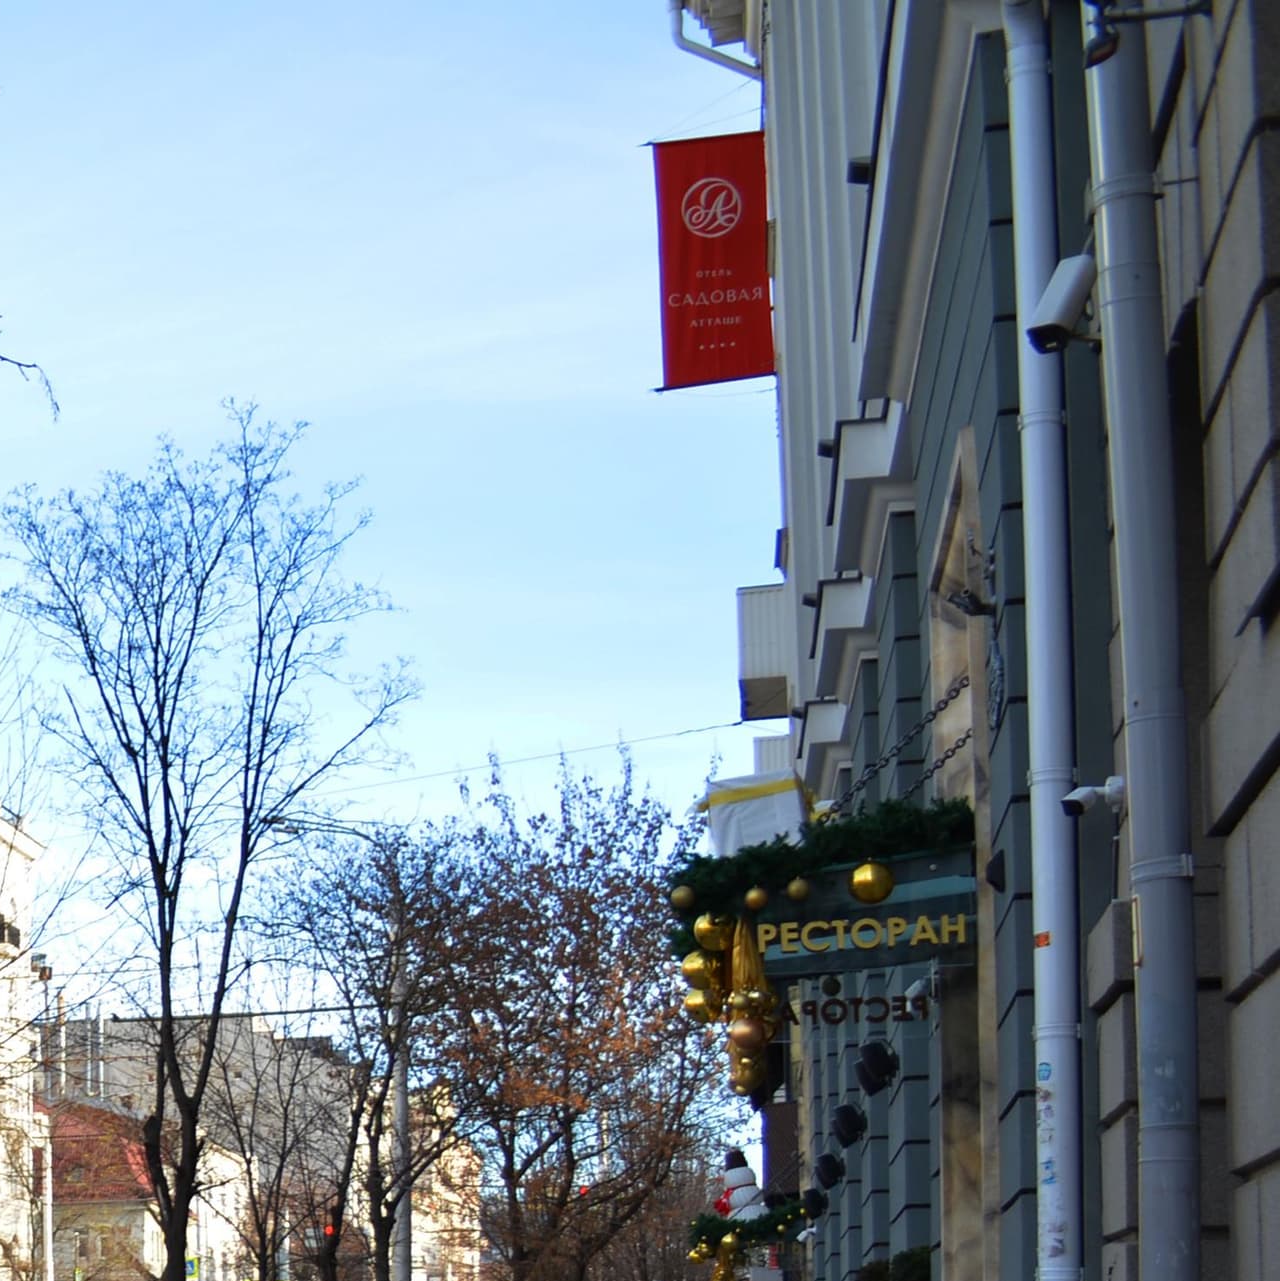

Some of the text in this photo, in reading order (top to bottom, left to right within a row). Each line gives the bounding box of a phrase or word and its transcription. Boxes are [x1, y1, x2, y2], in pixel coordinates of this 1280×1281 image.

[695, 268, 733, 278] ОТЕЛЬ
[668, 286, 763, 308] САДОВАЯ
[689, 315, 742, 328] АТТАШЕ
[756, 913, 967, 954] РЕСТОРАН
